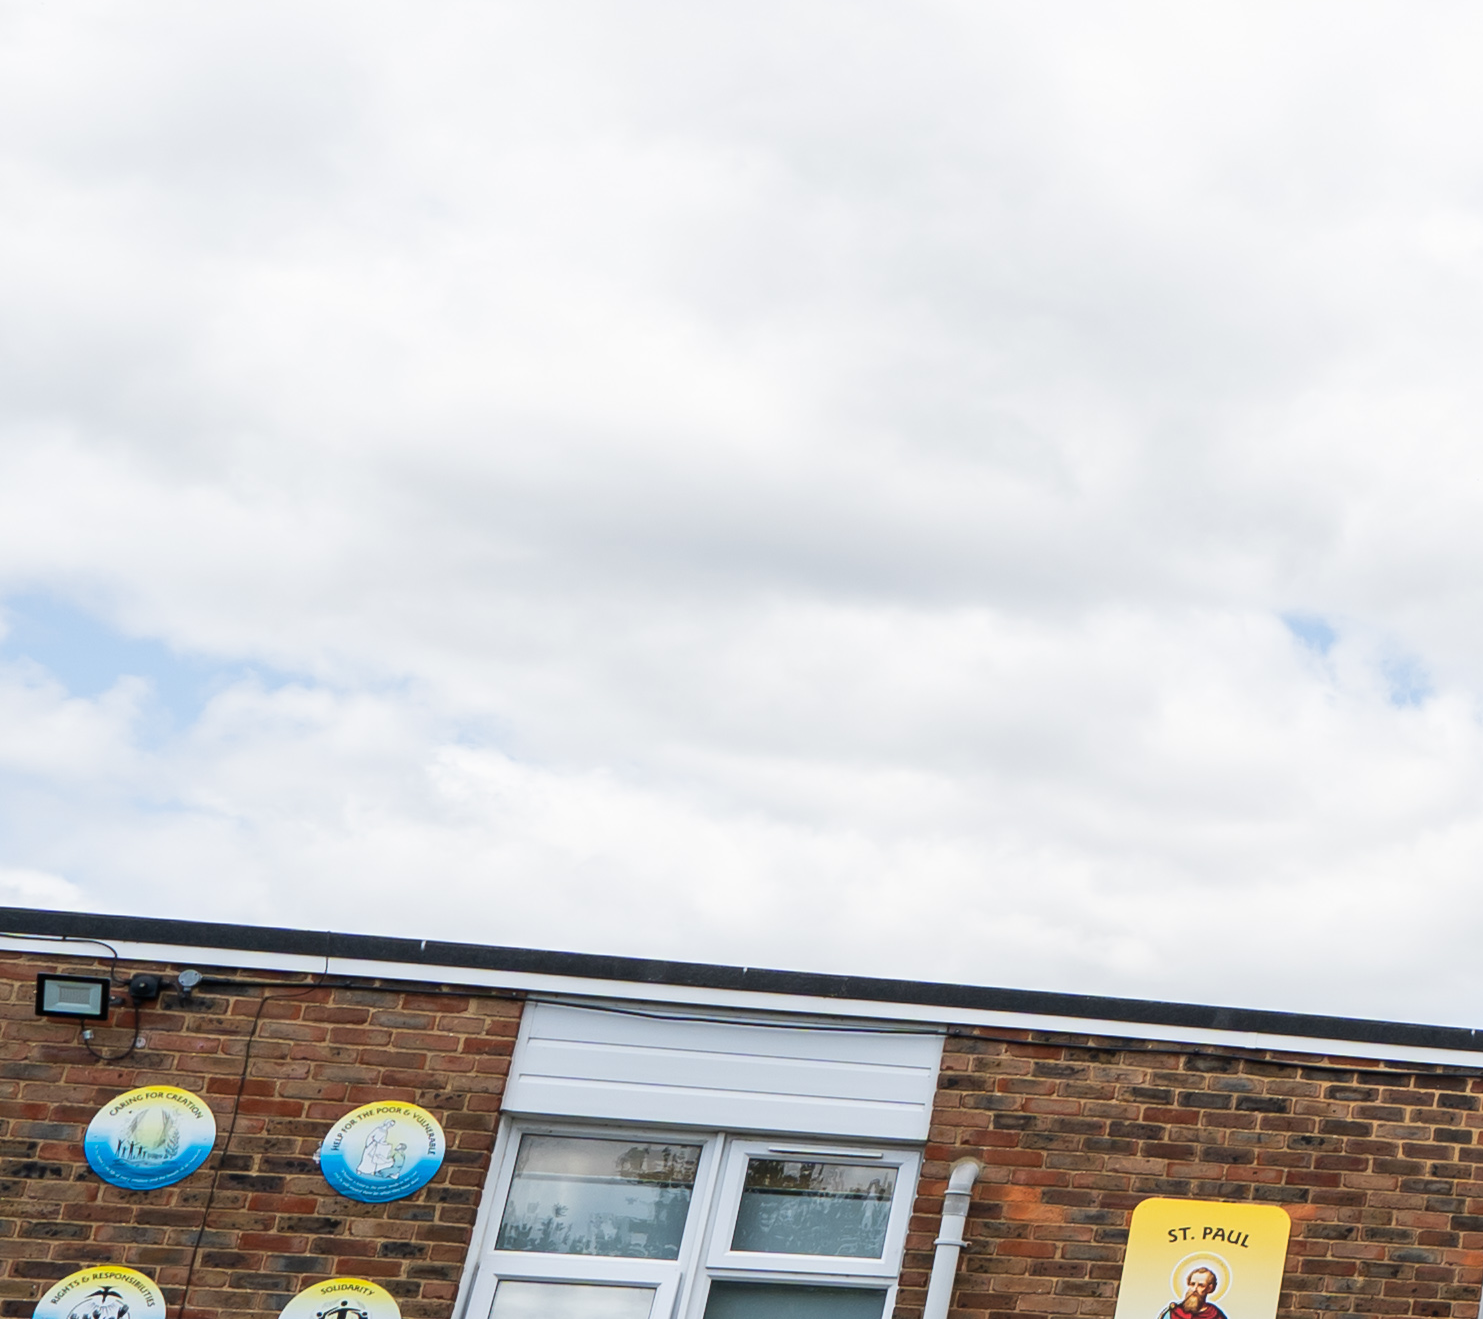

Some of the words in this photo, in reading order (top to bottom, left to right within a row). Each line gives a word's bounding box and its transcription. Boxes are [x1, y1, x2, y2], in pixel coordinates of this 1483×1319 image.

[109, 1093, 143, 1116] CARING
[165, 1092, 204, 1119] CREATION
[330, 1133, 343, 1151] HELP
[341, 1119, 357, 1134] FOR
[357, 1109, 375, 1121] THE
[413, 1112, 436, 1155] VULNERABLE
[1168, 1227, 1195, 1243] ST.
[1202, 1227, 1249, 1248] PAUL
[50, 1280, 80, 1304] RIGHTS
[92, 1272, 155, 1307] RESPONSIBILITIES
[321, 1284, 375, 1296] SOLIDARITY
